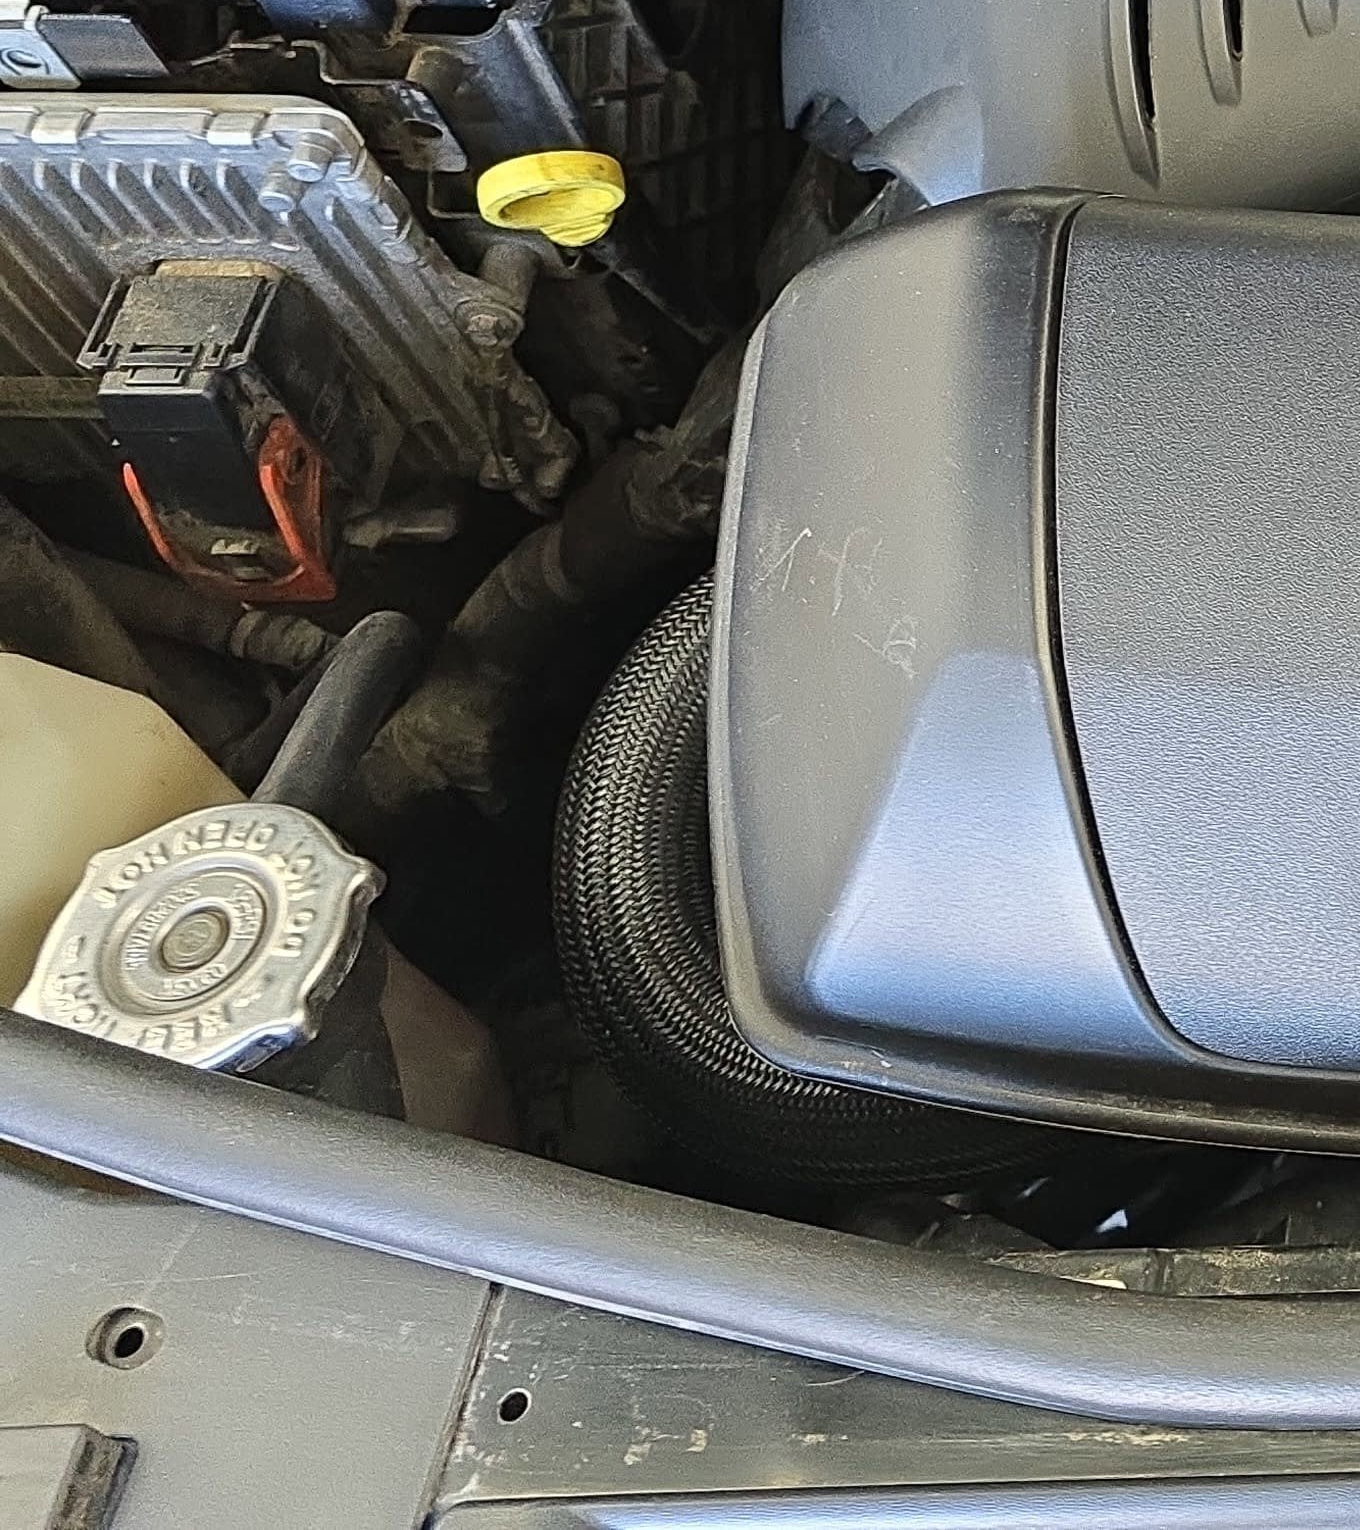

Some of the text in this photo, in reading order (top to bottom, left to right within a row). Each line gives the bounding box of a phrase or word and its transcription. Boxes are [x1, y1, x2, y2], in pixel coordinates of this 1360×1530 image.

[173, 819, 279, 856] OPEN
[271, 839, 322, 904] NOT
[270, 907, 317, 958] DO
